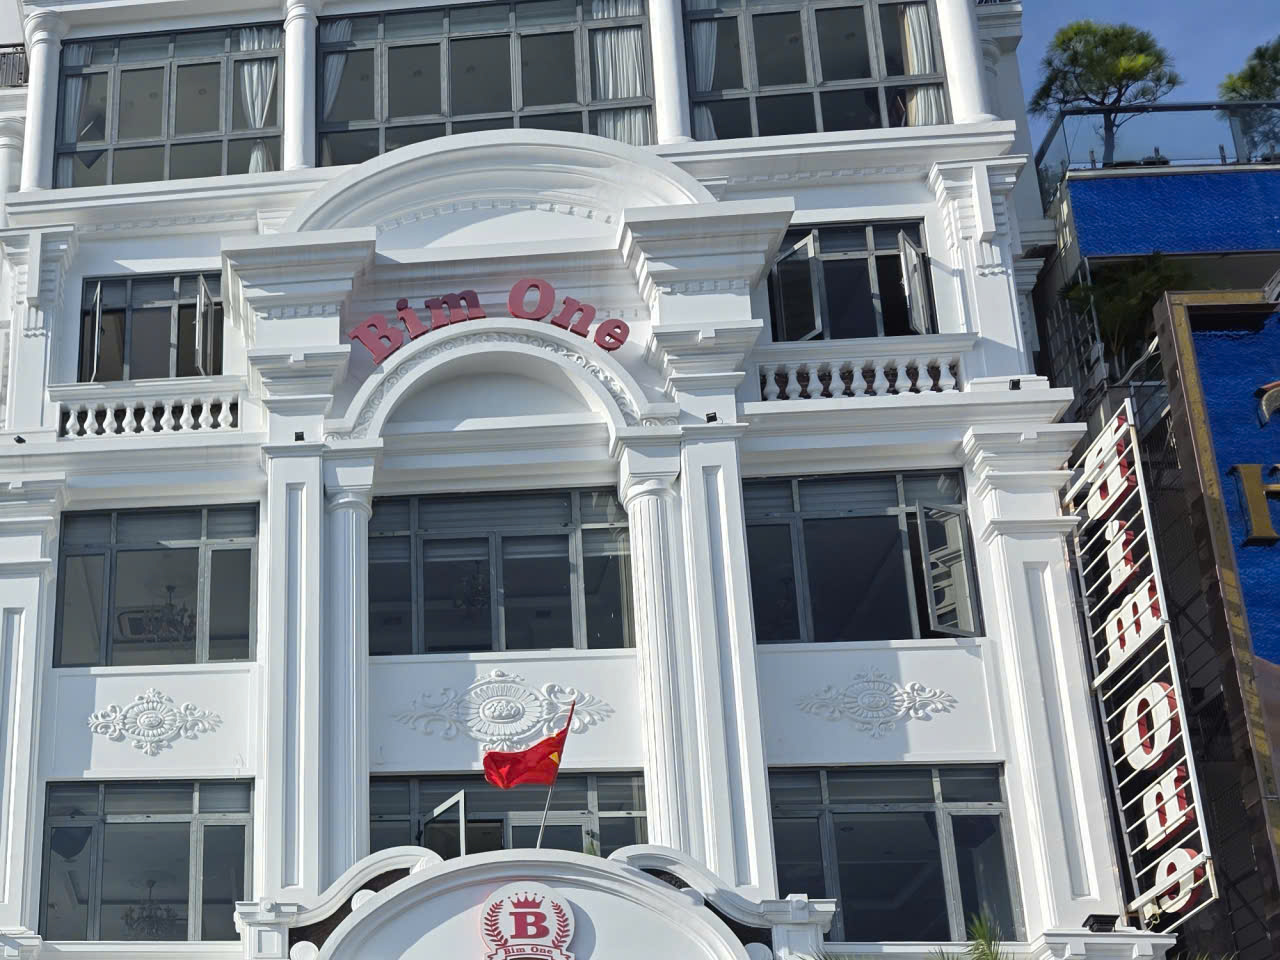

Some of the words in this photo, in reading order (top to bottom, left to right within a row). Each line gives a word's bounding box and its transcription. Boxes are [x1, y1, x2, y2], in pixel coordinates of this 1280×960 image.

[348, 289, 487, 365] Bim
[507, 278, 631, 351] One
[508, 911, 550, 940] B
[504, 946, 525, 955] Bim
[531, 946, 553, 955] One
